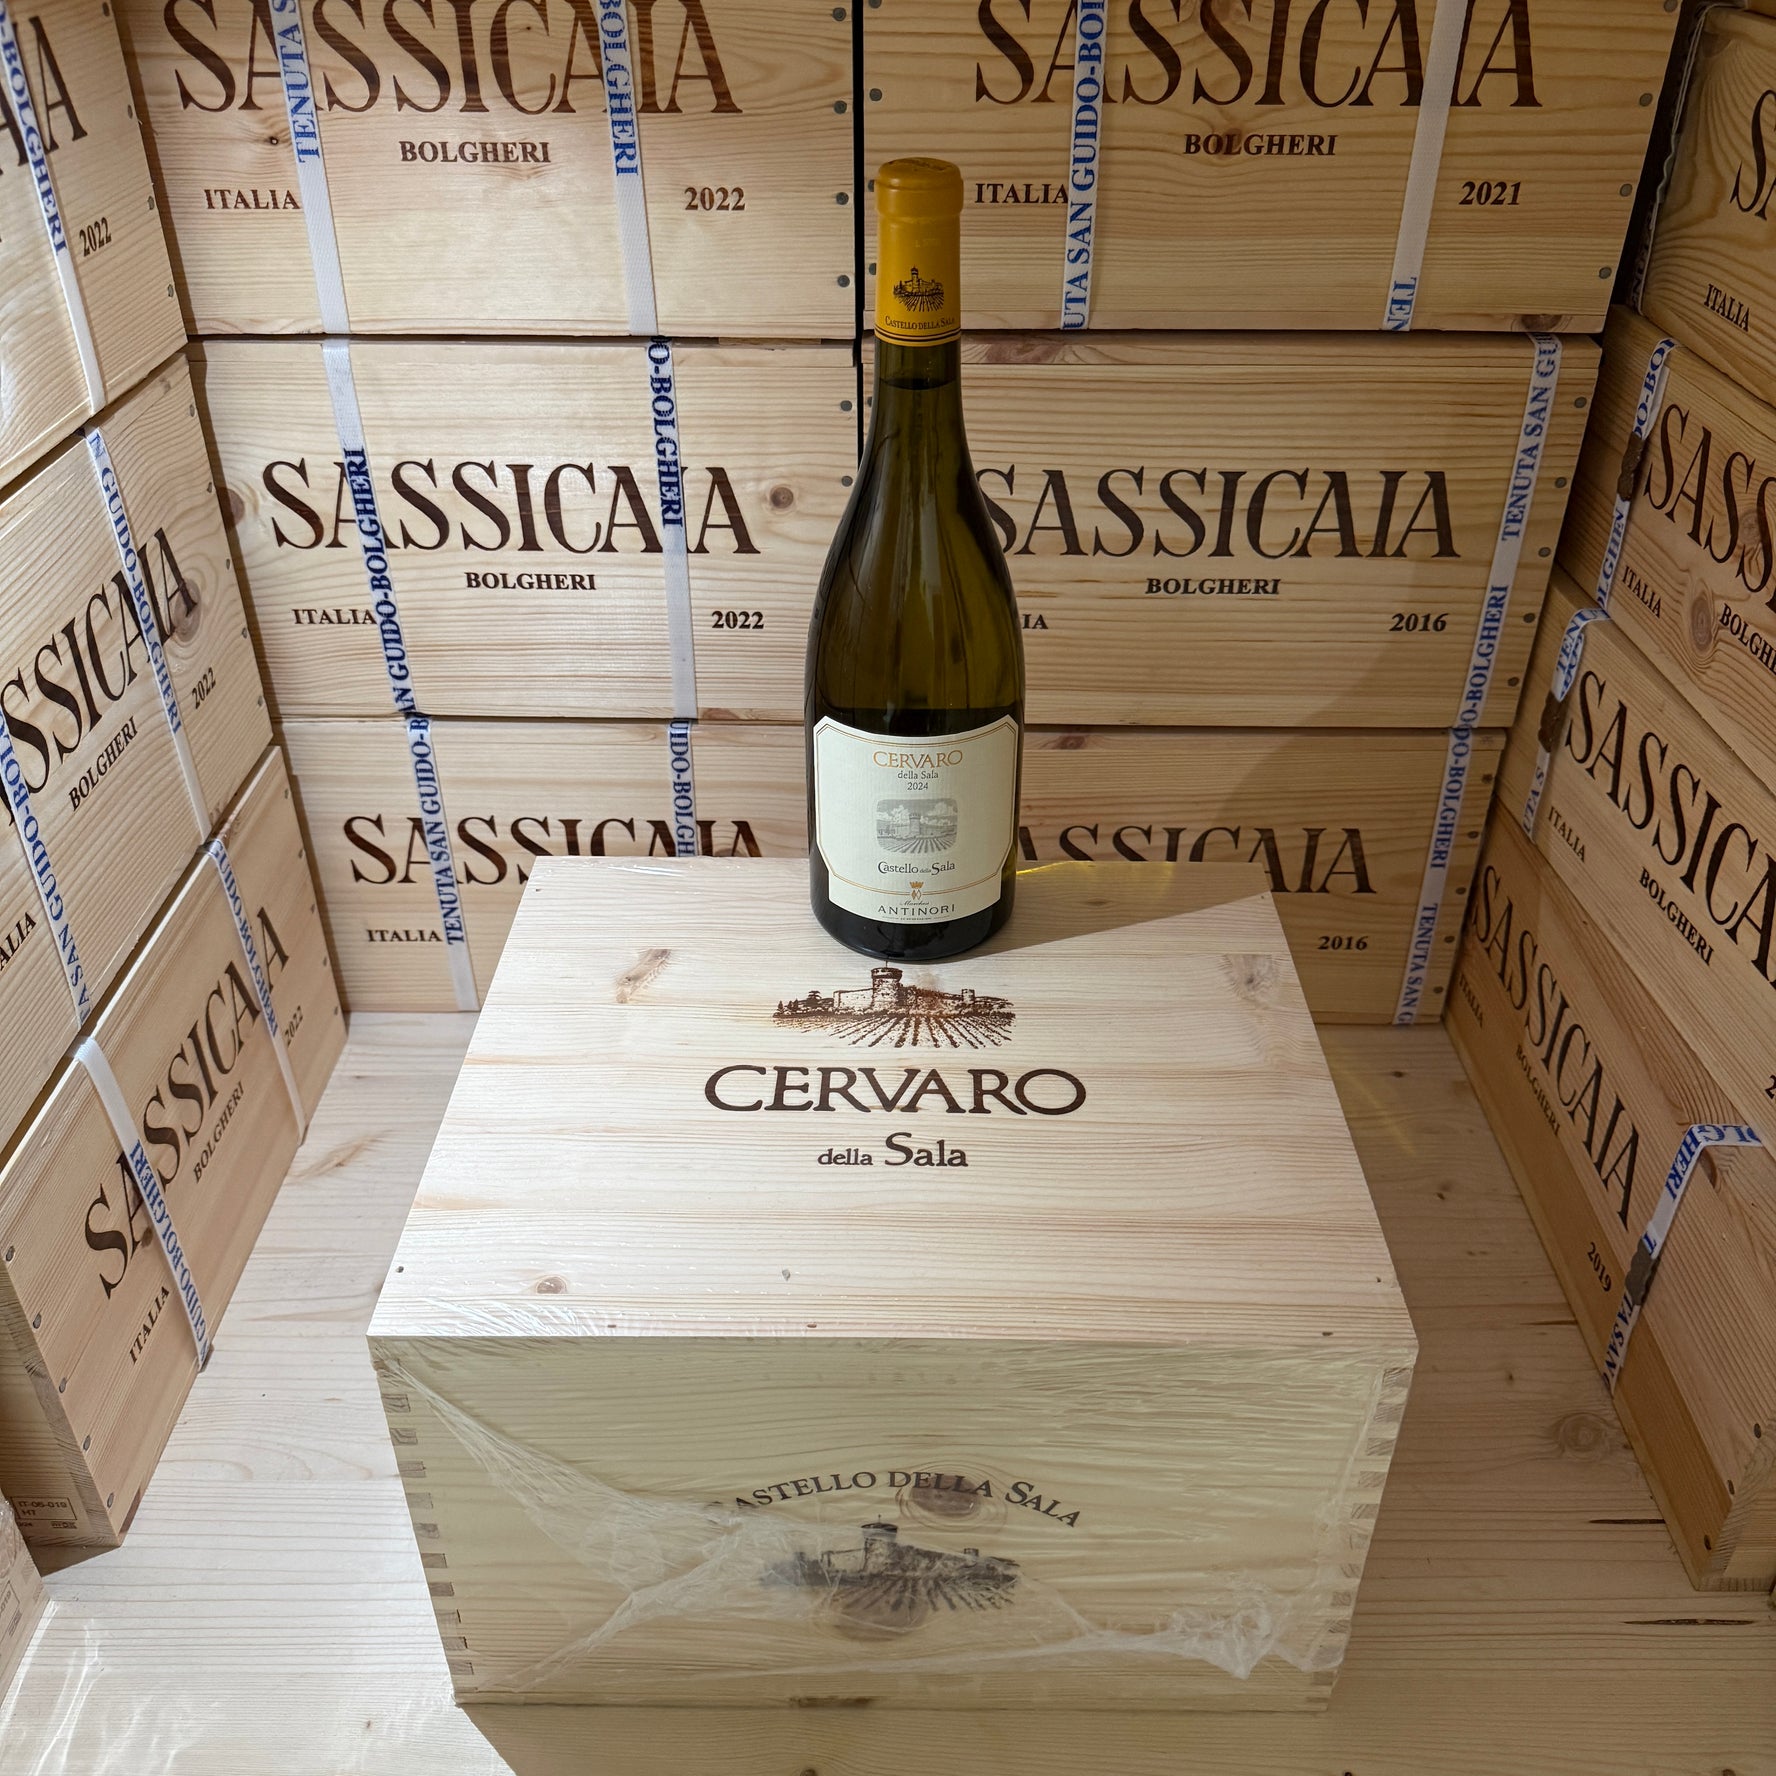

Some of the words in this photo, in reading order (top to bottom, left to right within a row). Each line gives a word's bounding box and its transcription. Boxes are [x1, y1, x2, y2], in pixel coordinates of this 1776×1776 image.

[401, 140, 552, 164] BOLGHERI
[1183, 133, 1339, 156] BOLGHERI
[204, 189, 301, 211] ITALIA
[684, 186, 746, 212] 2022
[974, 183, 1068, 205] ITALIA
[1458, 181, 1523, 207] 2021
[79, 217, 112, 257] 2022
[1066, 201, 1093, 265] SAN
[885, 315, 917, 330] CASTELLO
[918, 321, 940, 330] DELLA
[1703, 283, 1750, 332] ITALIA
[1502, 441, 1539, 541] TENUTA
[1524, 386, 1552, 438] SAN
[975, 464, 1461, 559] SASSICAIA
[464, 572, 597, 592] BOLGHERI
[1145, 577, 1282, 595] BOLGHERI
[1622, 565, 1662, 619] ITALIA
[292, 608, 377, 625] ITALIA
[711, 611, 765, 630] 2022
[1389, 612, 1449, 632] 2016
[191, 667, 217, 710] 2022
[68, 716, 138, 812] BOLGHERI
[873, 749, 963, 769] CERVARO
[897, 770, 918, 780] della
[920, 770, 939, 780] Sala
[907, 781, 929, 791] 2024
[426, 821, 450, 862] SAN
[1547, 805, 1587, 863] ITALIA
[877, 861, 919, 874] Castello
[931, 860, 956, 876] Sala
[435, 868, 466, 946] TENUTA
[877, 903, 955, 916] ANTINORI
[1638, 867, 1715, 966] BOLGHERI
[58, 923, 84, 987] SAN
[366, 929, 442, 942] ITALIA
[1317, 935, 1369, 951] 2016
[1409, 903, 1438, 973] TENUTA
[1458, 972, 1485, 1029] ITALIA
[284, 1005, 304, 1048] 2022
[1472, 865, 1639, 1232] SASSICAIA
[704, 1064, 1087, 1116] CERVARO
[1515, 1044, 1561, 1137] BOLGHERI
[193, 1081, 244, 1184] BOLGHERI
[816, 1147, 874, 1167] della
[885, 1131, 969, 1168] Sala
[1587, 1241, 1612, 1293] 2019
[129, 1286, 170, 1364] ITALIA
[888, 1470, 992, 1498] DELLA
[1004, 1480, 1082, 1528] SALA
